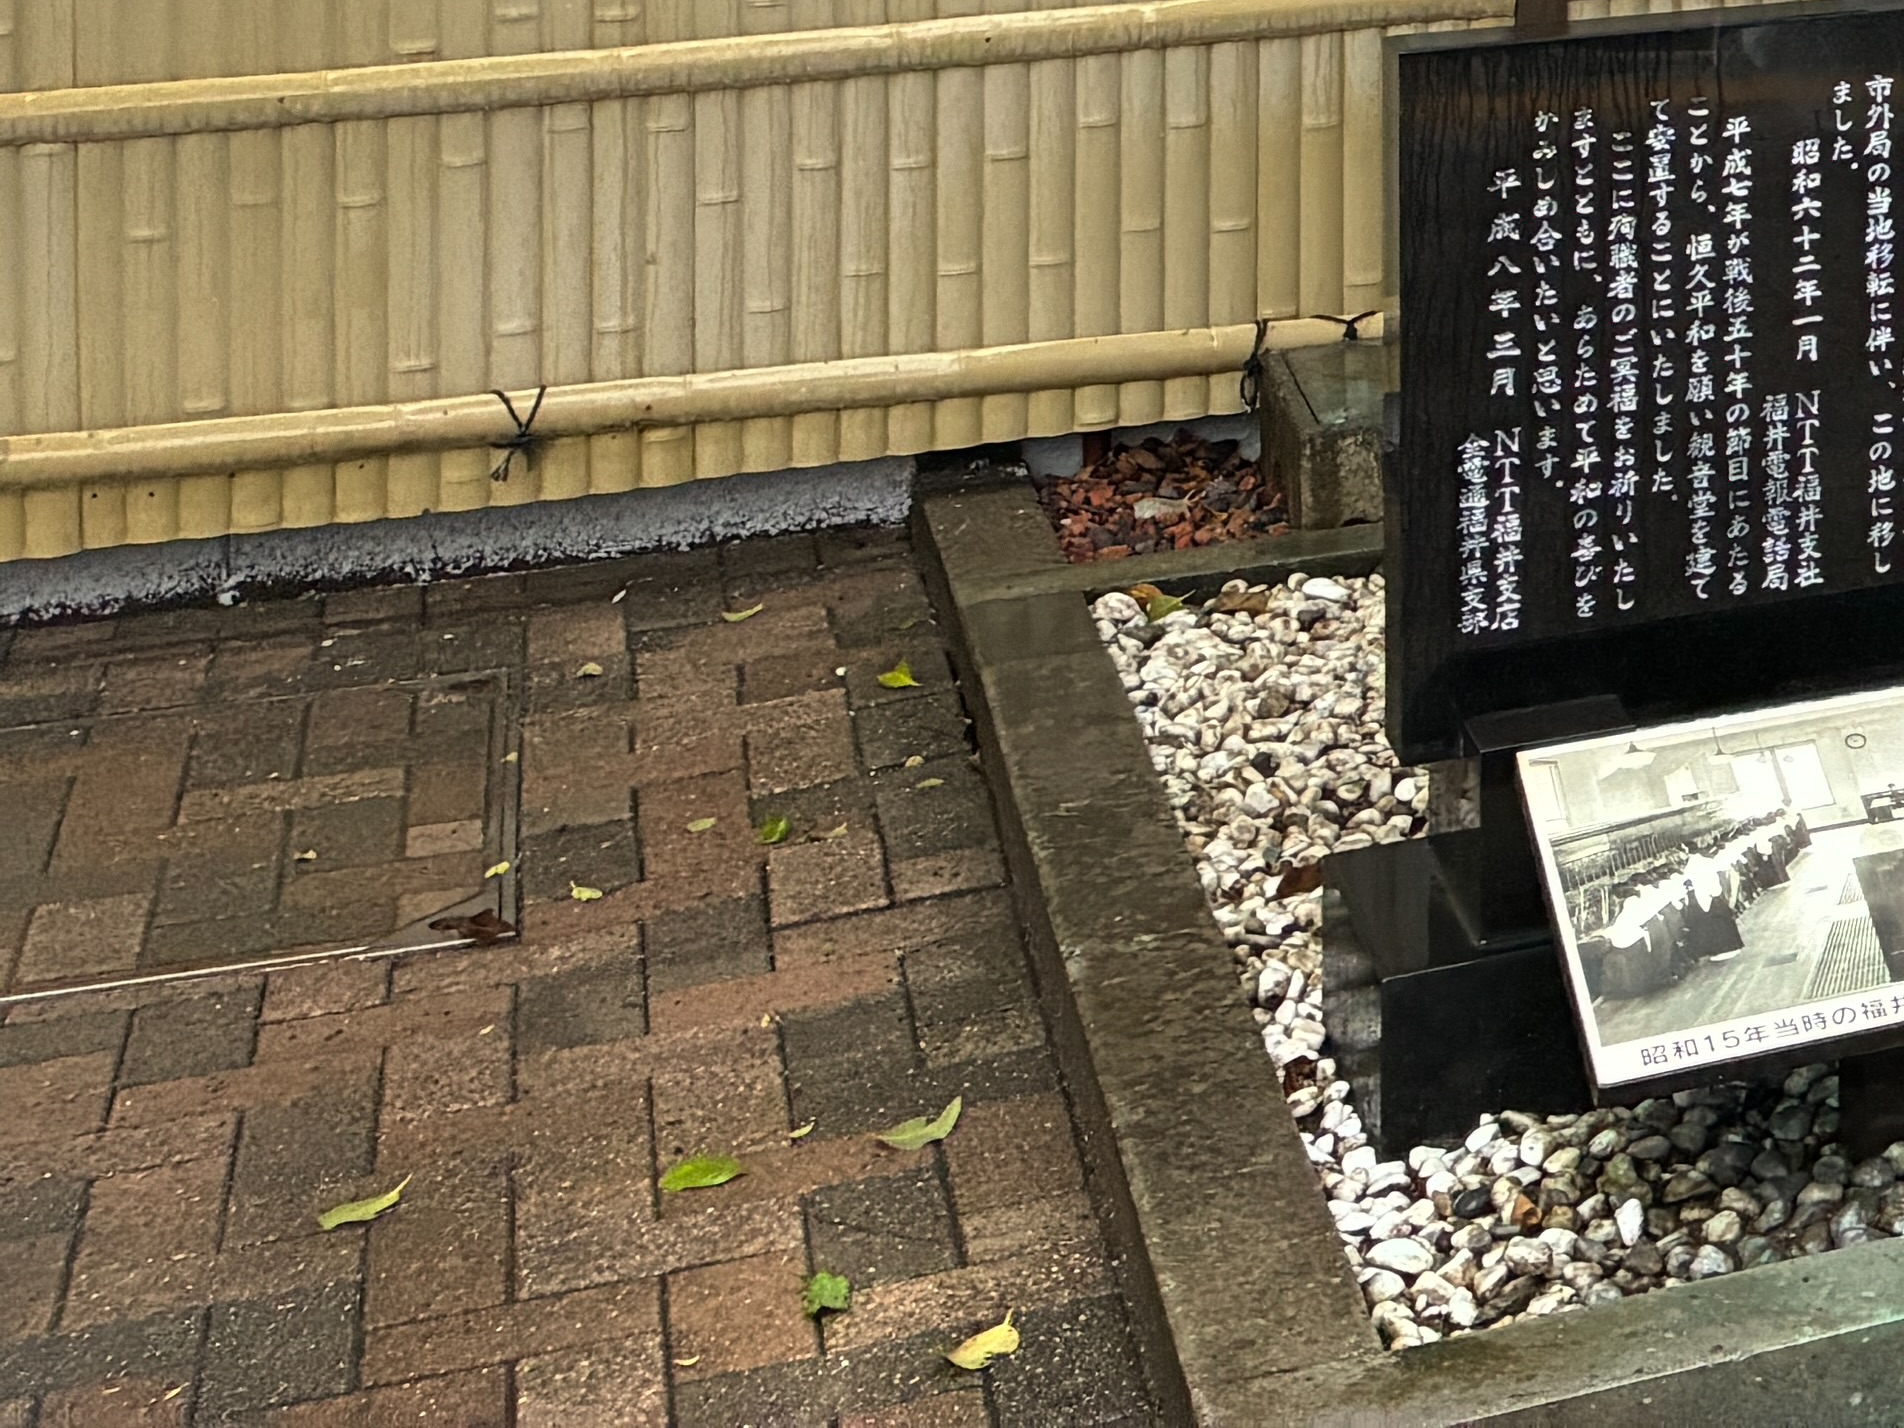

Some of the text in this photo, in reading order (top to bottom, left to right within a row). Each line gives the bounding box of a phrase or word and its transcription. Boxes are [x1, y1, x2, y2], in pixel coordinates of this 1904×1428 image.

[1530, 110, 1564, 488] かみしめ合いたいと思います。
[1645, 98, 1678, 501] て安置することにいたしました。
[1832, 81, 1859, 170] ました。
[1457, 433, 1490, 634] 全電通福井県支部
[1486, 168, 1523, 631] 平成八年三月 NTT福井支店
[1607, 131, 1640, 610] ここに殉職者のご冥福をお祈りいたし
[1722, 115, 1754, 595] 平成七年が戦後五十年の節目にあたる
[1760, 394, 1793, 591] 福井電報電話局
[1791, 138, 1824, 588] 昭和六十二年一月 NTT福井支社
